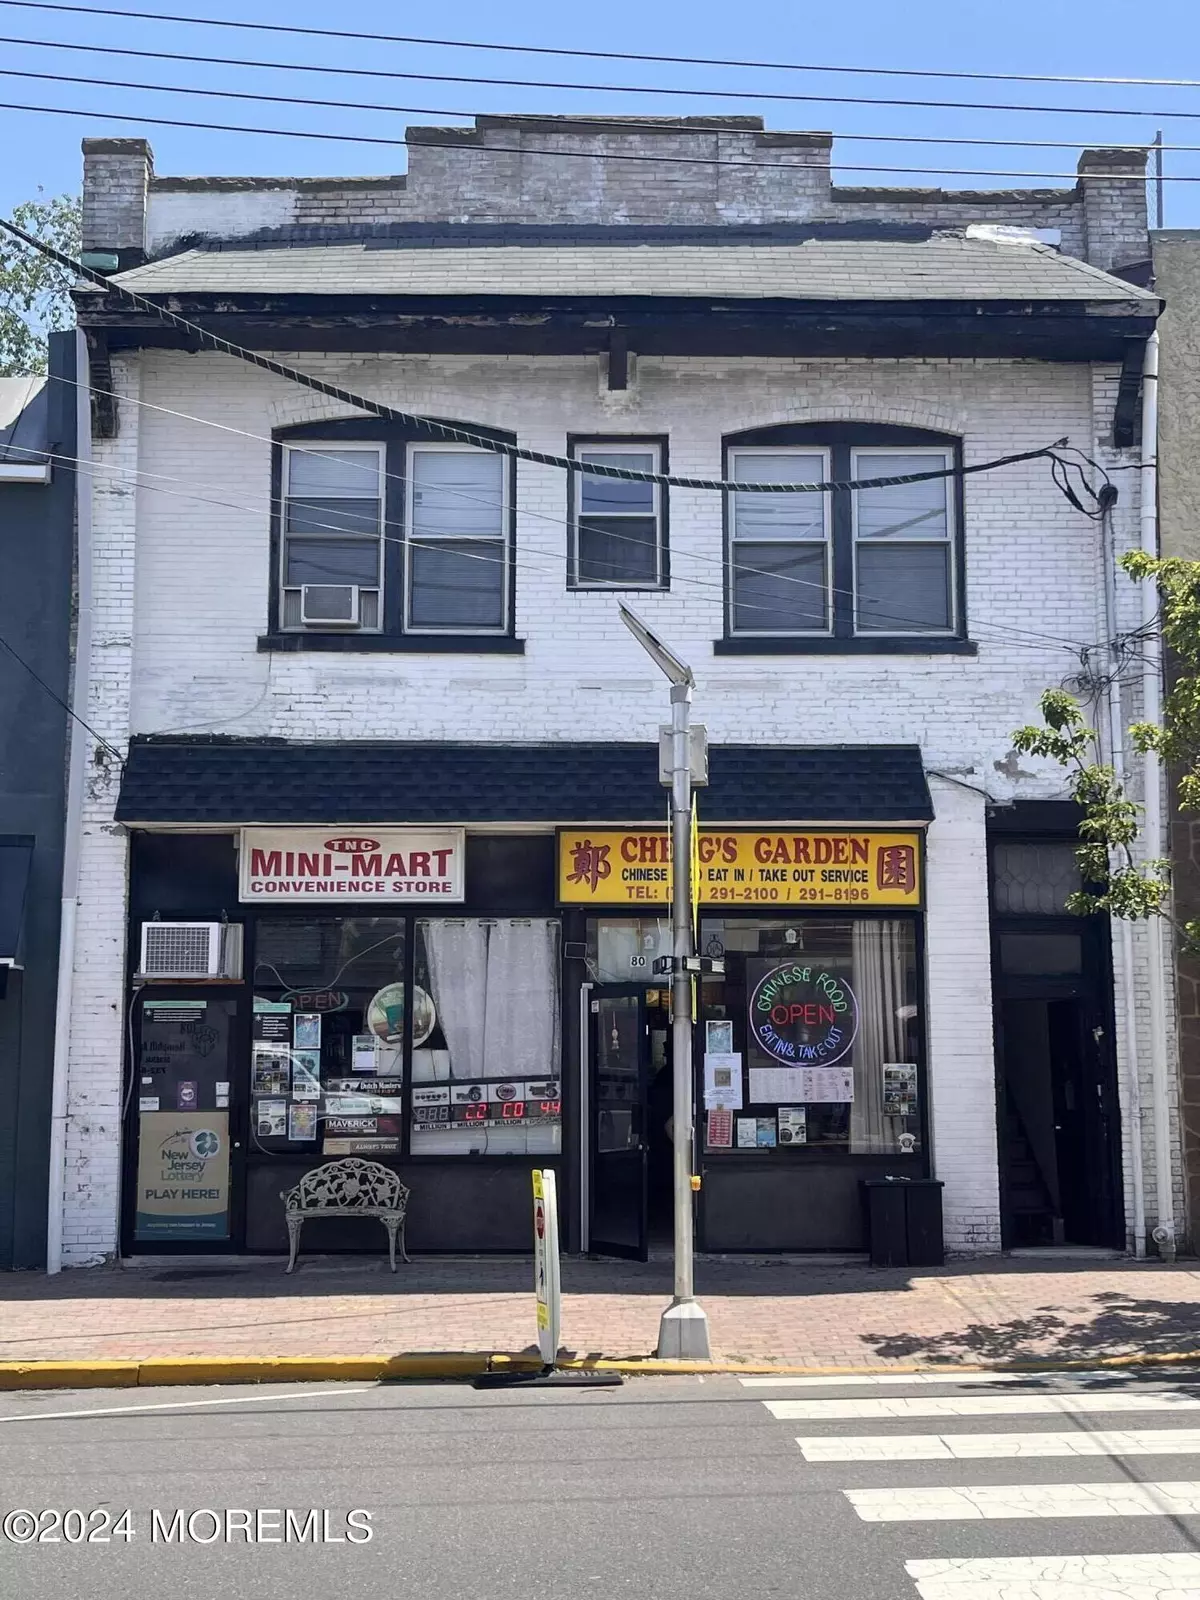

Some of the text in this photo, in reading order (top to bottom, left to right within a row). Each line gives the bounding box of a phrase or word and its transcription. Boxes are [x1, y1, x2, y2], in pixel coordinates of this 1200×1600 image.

[332, 840, 373, 850] TNC
[620, 837, 870, 864] CHEG'S GARDEN
[251, 848, 453, 877] MINI-MART
[622, 868, 667, 881] CHINESE
[708, 869, 729, 882] EAT
[734, 869, 745, 882] IN
[759, 869, 788, 882] TAKE
[792, 869, 814, 882] OUT
[821, 869, 868, 883] SERVICE
[251, 880, 452, 893] CONVENIENCE STORE
[626, 886, 658, 899] TEL:
[710, 887, 779, 900] 291-2100
[799, 888, 869, 901] 291-8196
[631, 956, 645, 966] 80
[757, 966, 847, 1012] CHINESE FOOD
[286, 991, 341, 1010] OPEN
[771, 1003, 836, 1025] OPEN
[759, 1024, 778, 1045] EAT
[799, 1042, 827, 1059] TAKE
[824, 1025, 843, 1049] OUT
[328, 1120, 374, 1128] MAVERICK
[162, 1149, 188, 1160] New
[167, 1160, 206, 1172] Jersey
[161, 1170, 205, 1182] Lottery
[145, 1189, 220, 1199] PLAY HERE!
